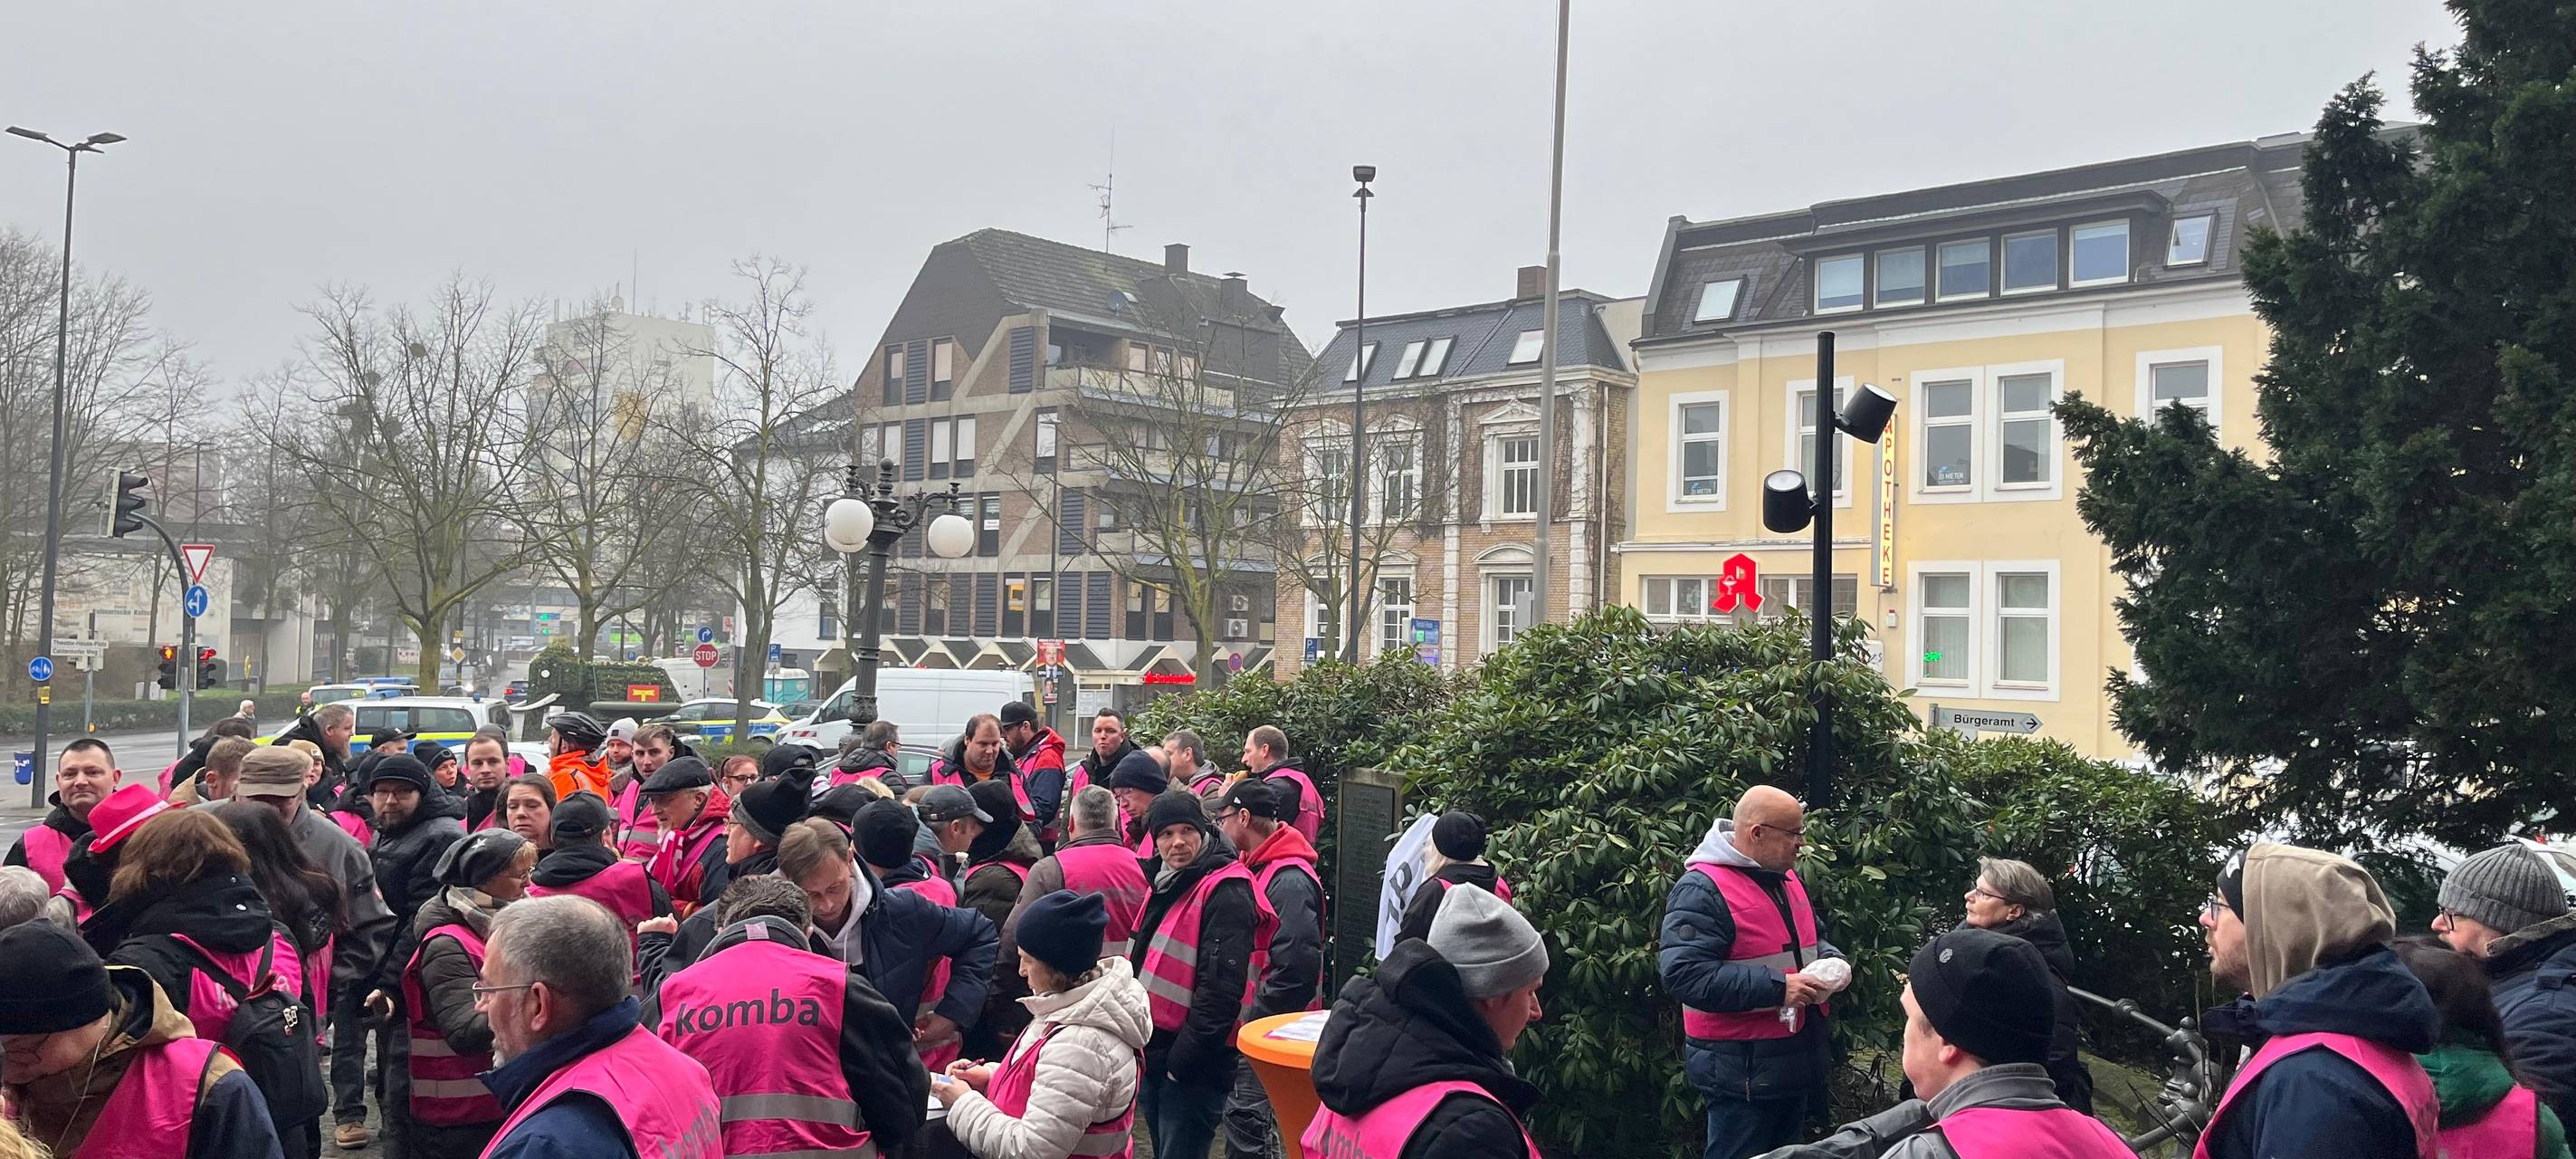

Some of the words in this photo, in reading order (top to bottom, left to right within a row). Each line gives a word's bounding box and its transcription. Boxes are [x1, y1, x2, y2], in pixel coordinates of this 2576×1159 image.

[695, 650, 717, 661] STOP
[1953, 714, 2015, 727] Bürgeramt
[675, 988, 820, 1037] komba
